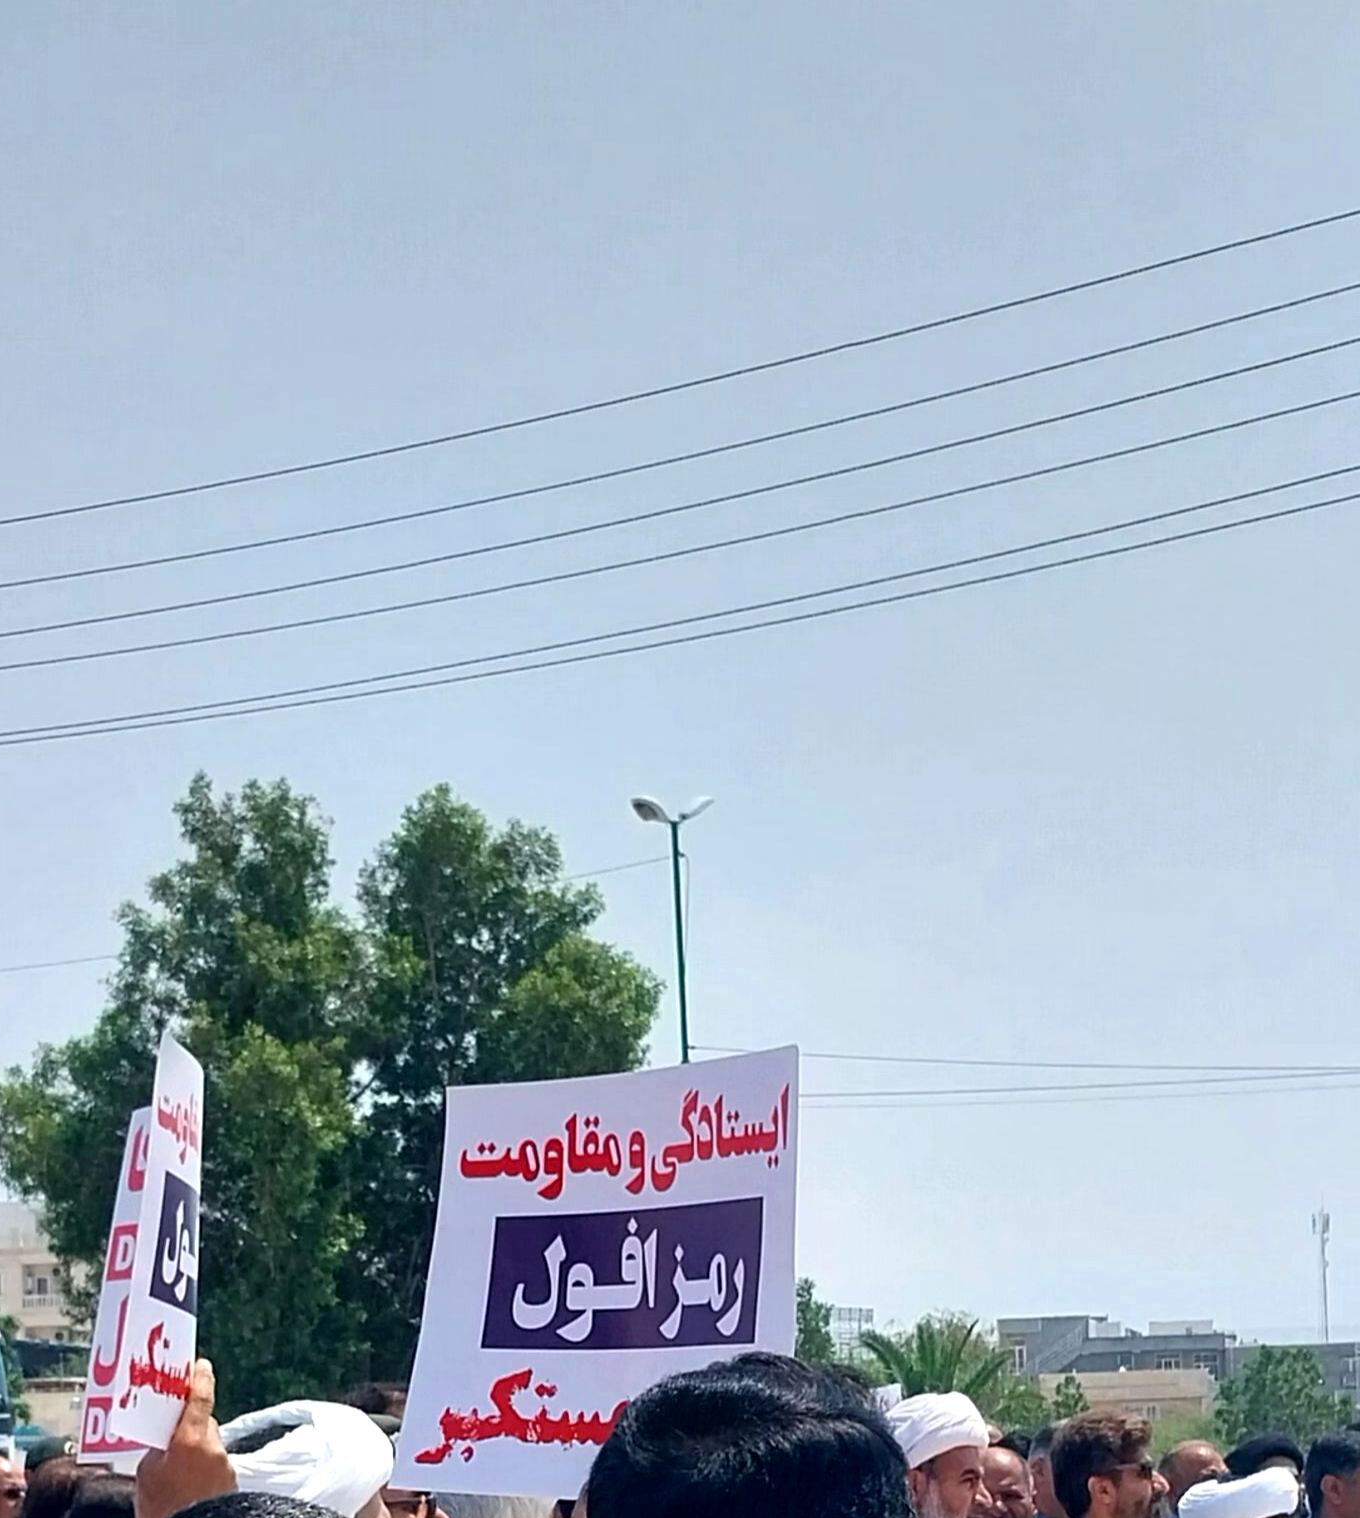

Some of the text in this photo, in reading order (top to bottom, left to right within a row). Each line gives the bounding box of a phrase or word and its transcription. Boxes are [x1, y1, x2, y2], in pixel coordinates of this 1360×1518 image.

[458, 1083, 790, 1200] ایستادگی و مقاومت
[511, 1216, 746, 1342] رمز افول
